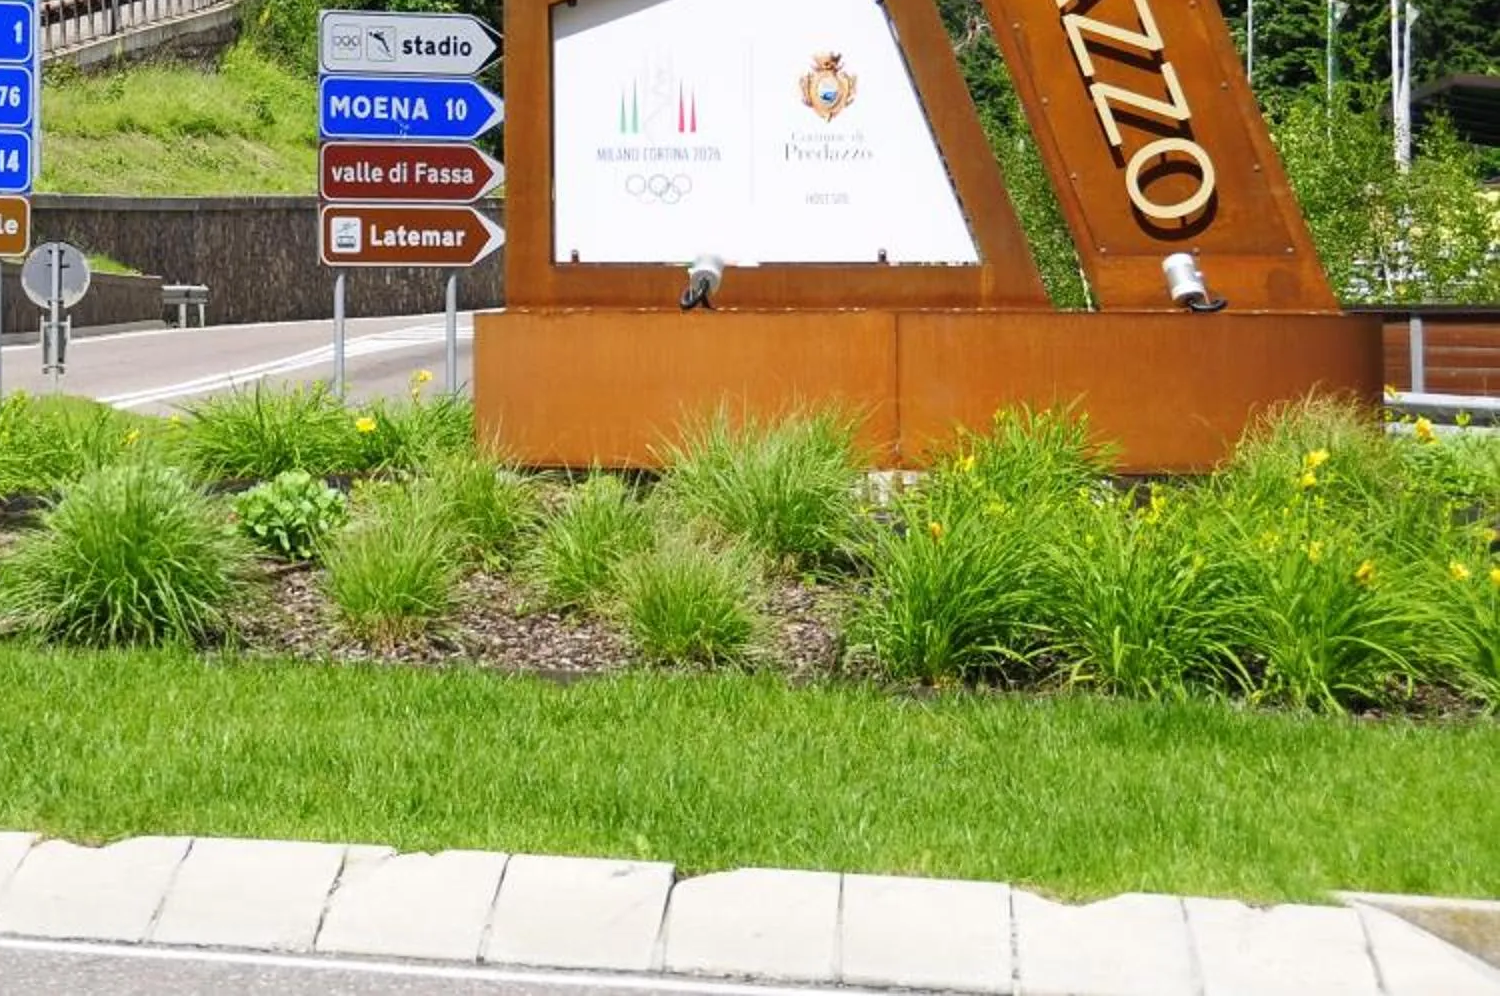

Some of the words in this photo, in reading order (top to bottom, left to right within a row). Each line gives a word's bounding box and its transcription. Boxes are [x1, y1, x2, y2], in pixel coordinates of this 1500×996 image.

[13, 21, 23, 44] 1
[402, 35, 473, 57] stadio
[330, 94, 429, 121] MOENA
[445, 98, 468, 121] 10
[331, 162, 384, 183] valle
[389, 162, 408, 184] di
[415, 162, 474, 185] Fassa
[370, 224, 467, 248] Latemar
